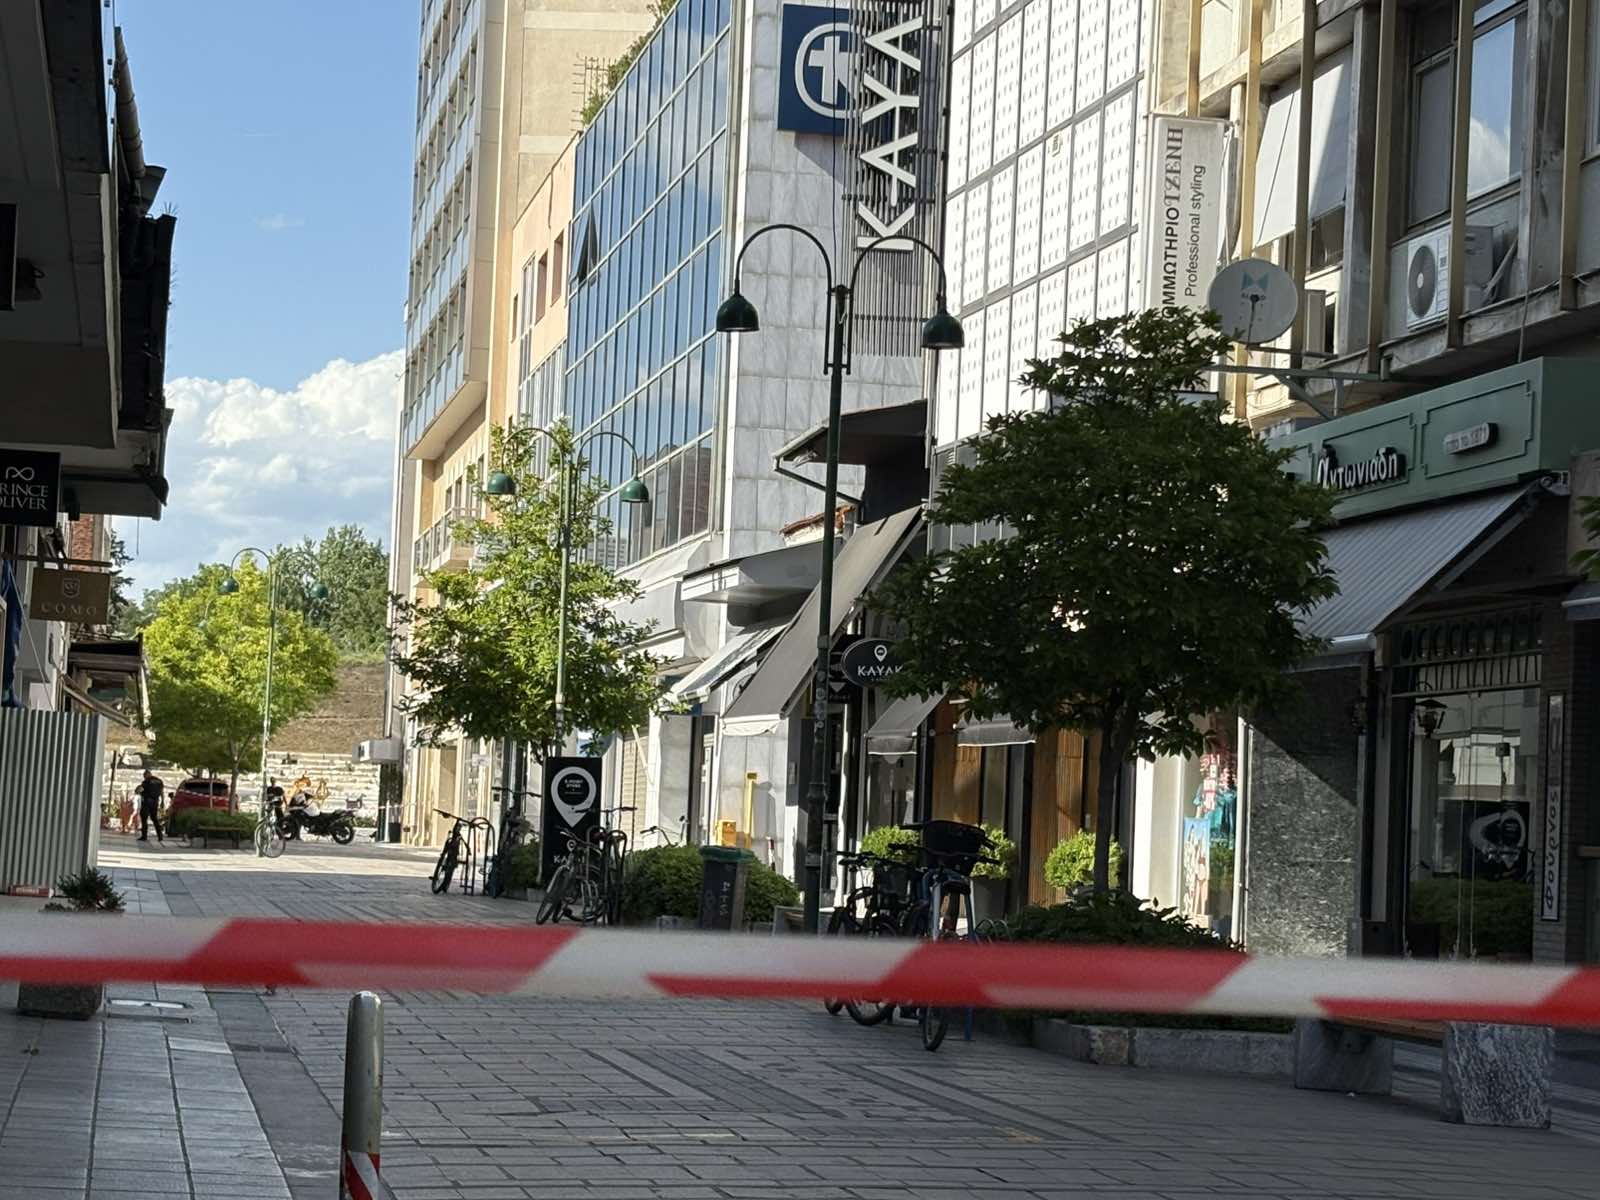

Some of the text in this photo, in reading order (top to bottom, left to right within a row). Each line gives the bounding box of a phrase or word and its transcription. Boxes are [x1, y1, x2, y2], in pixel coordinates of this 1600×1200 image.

[1161, 207, 1180, 318] ΟΜΜΩΤΗΡΙΟ
[1184, 164, 1206, 297] Professional styling
